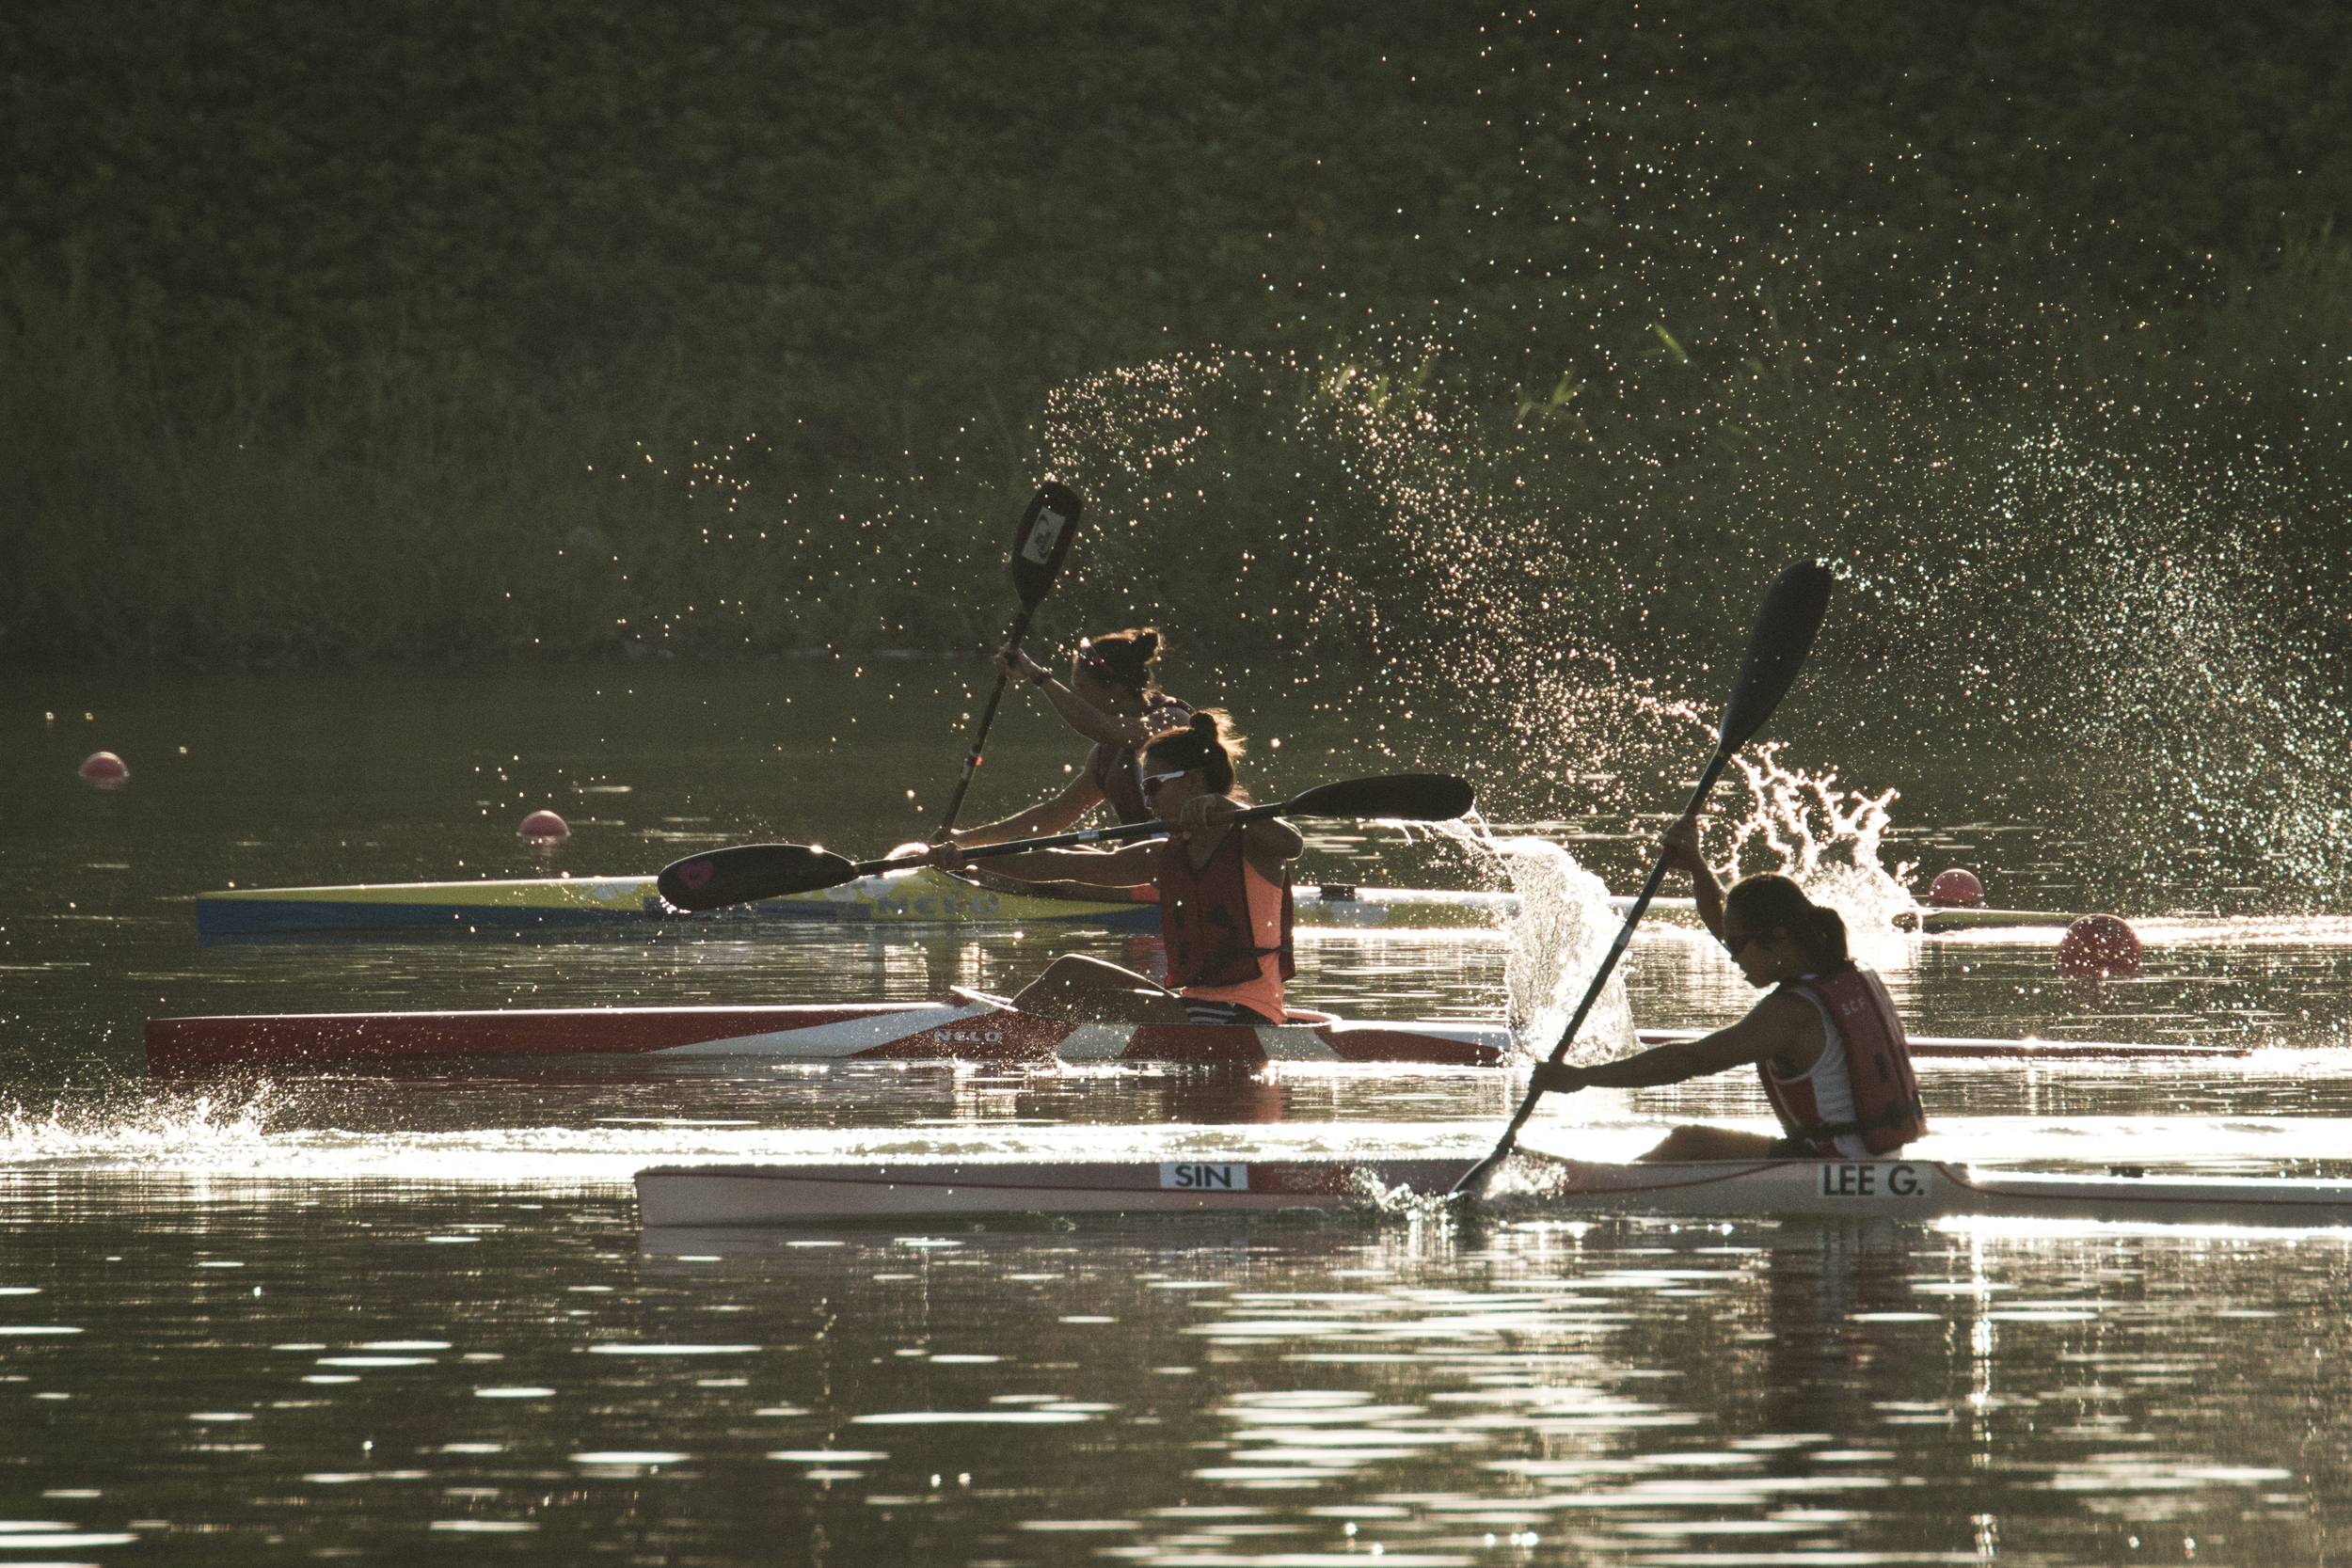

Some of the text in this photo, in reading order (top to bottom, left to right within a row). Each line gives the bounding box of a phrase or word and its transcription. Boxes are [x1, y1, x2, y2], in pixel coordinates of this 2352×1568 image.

[933, 1030, 1000, 1042] NELO
[1175, 1164, 1232, 1188] SIN
[1823, 1164, 1925, 1196] LEE G.
